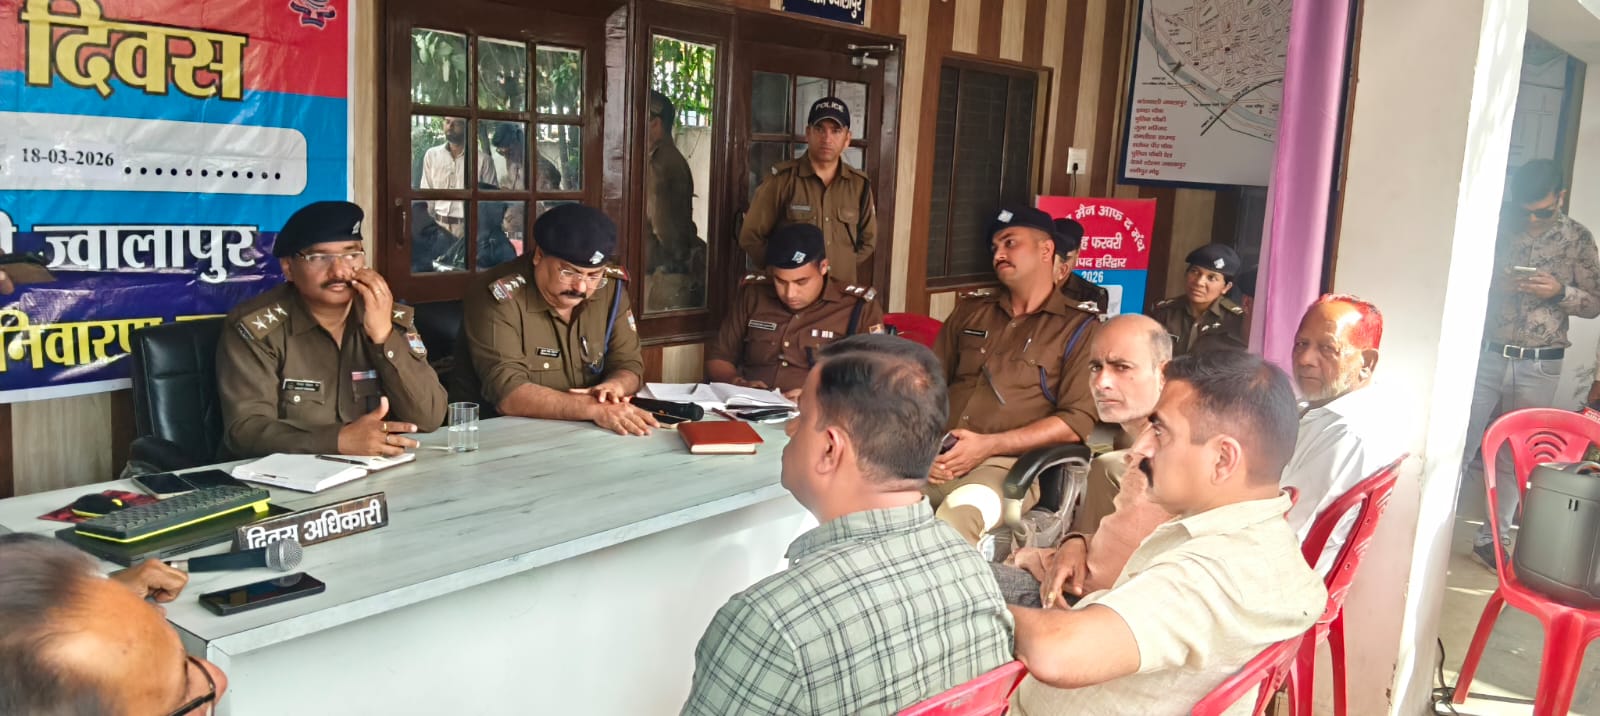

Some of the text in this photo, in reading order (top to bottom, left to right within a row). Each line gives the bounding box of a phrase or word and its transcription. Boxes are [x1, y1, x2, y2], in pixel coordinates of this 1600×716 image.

[19, 0, 249, 101] दिवस
[815, 101, 844, 113] POLICE
[21, 147, 115, 167] 18-03-2026
[1091, 232, 1123, 250] फरवरी
[33, 224, 258, 284] ज्वालापुर
[1095, 254, 1128, 269] हरिद्वार
[303, 499, 383, 541] अधिकारी
